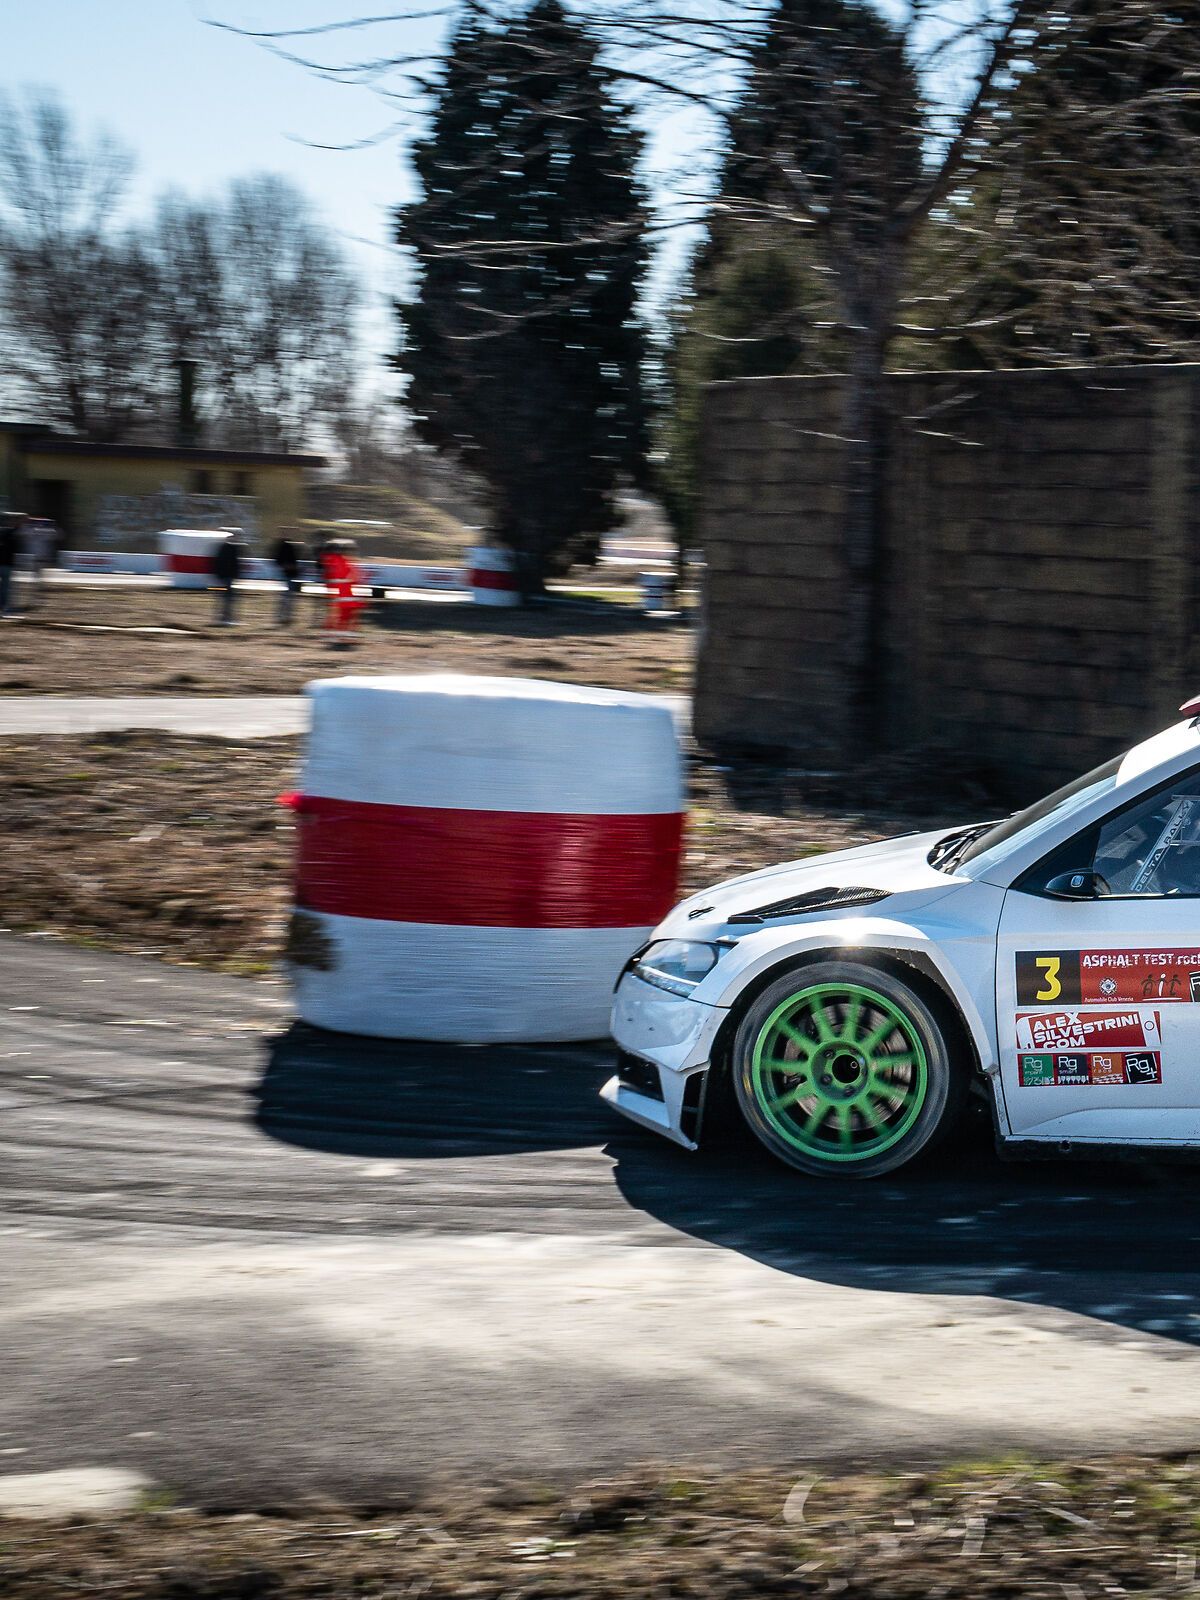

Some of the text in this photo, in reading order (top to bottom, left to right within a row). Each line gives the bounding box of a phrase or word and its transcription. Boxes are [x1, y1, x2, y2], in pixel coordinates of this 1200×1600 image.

[1135, 802, 1190, 892] DELTA RALLY
[1083, 954, 1140, 967] ASPHALT
[1143, 953, 1174, 965] TEST
[1035, 956, 1062, 1000] 3
[1033, 1012, 1082, 1033] ALEX
[1034, 1014, 1139, 1043] SILVESTRINI
[1024, 1057, 1043, 1070] Rg
[1058, 1056, 1078, 1070] Rg
[1092, 1055, 1112, 1070] Rg
